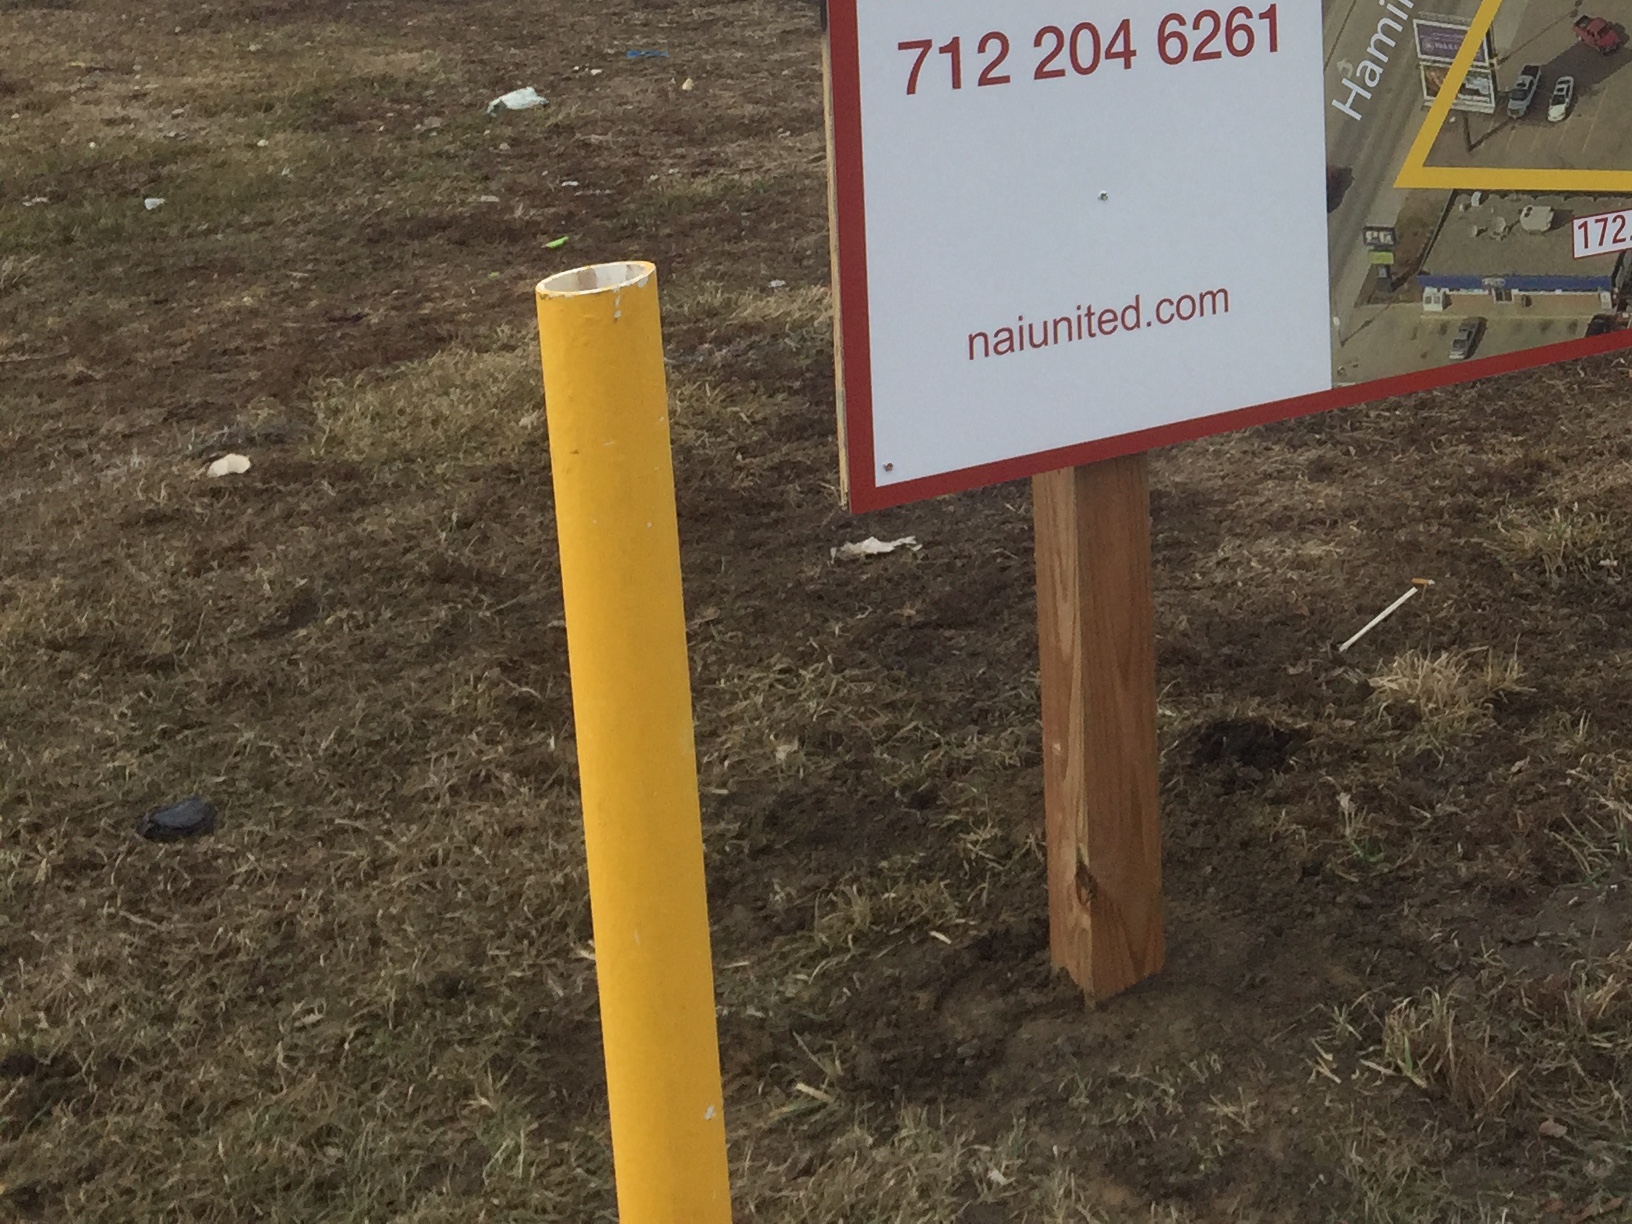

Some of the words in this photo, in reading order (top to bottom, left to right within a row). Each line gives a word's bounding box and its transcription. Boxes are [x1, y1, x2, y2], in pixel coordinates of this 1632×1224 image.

[897, 31, 1011, 95] 712
[1033, 18, 1136, 80] 204
[1157, 3, 1279, 66] 6261
[967, 287, 1229, 361] naiunited.com
